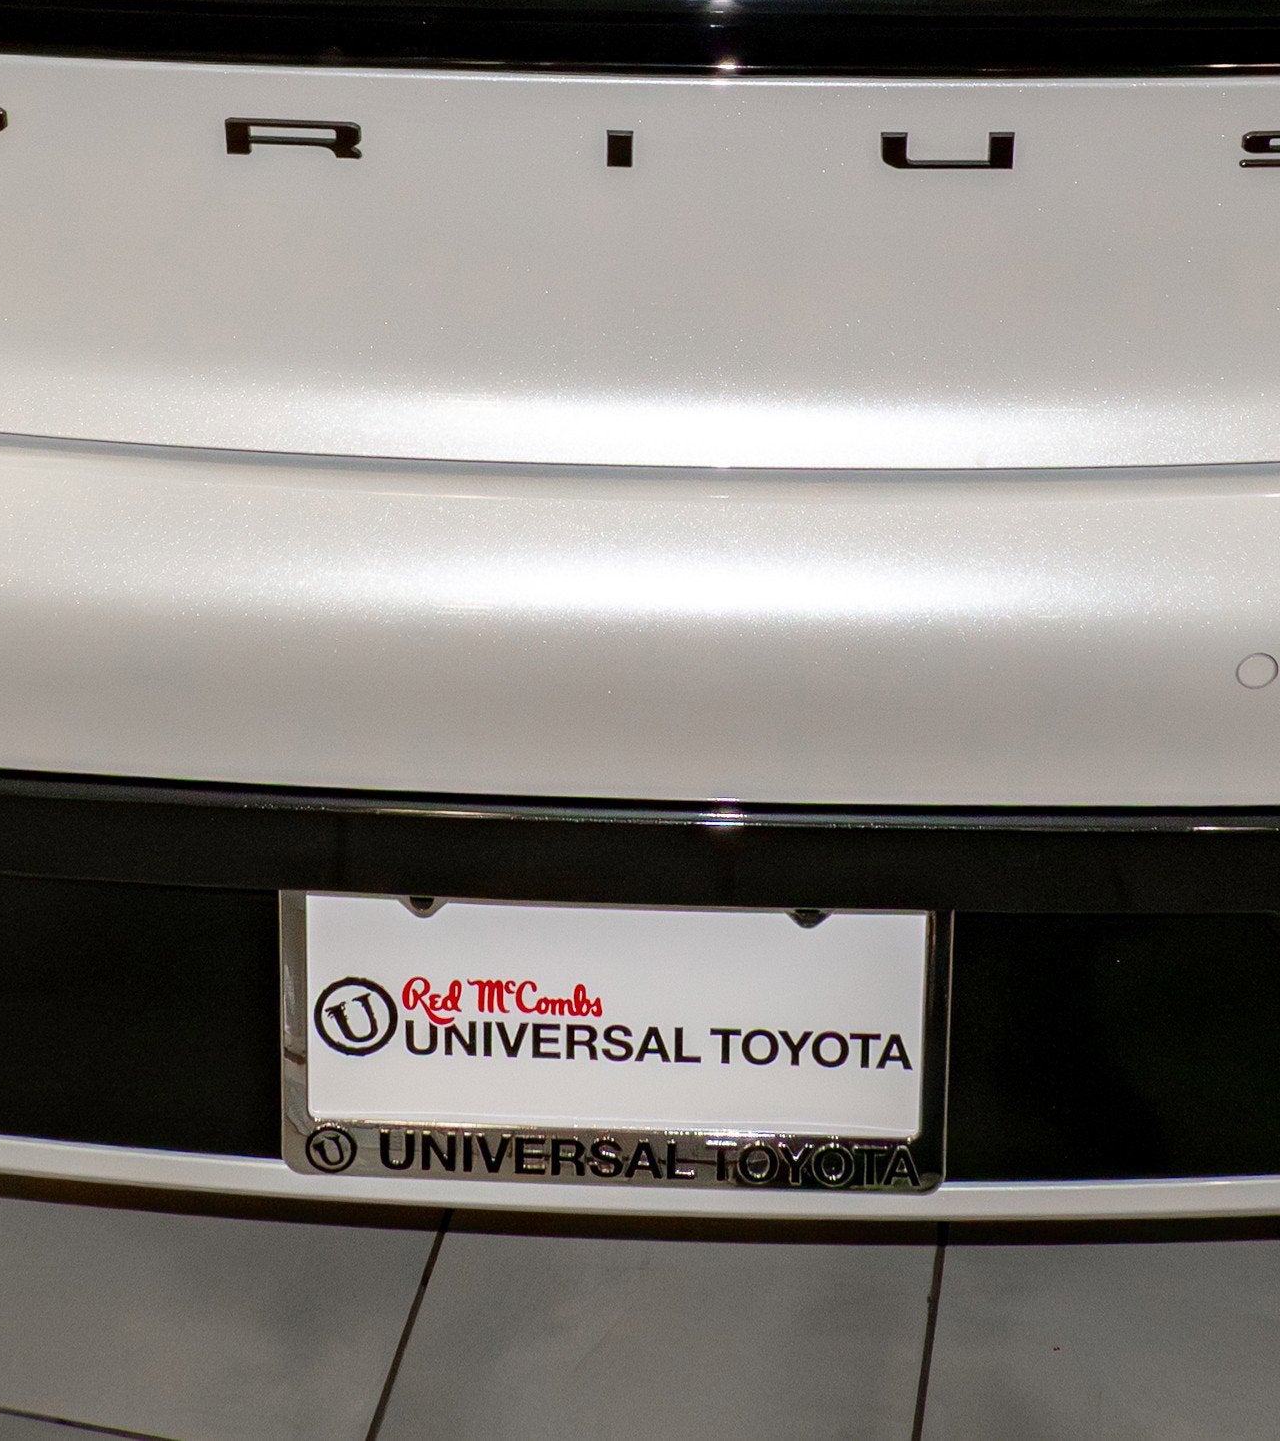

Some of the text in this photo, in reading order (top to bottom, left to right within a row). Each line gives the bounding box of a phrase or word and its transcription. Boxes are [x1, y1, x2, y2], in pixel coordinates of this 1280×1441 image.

[402, 976, 602, 1025] Red McCombs
[405, 1020, 913, 1071] UNIVERSAL TOYOTA
[378, 1128, 921, 1188] UNIVERSAL TOYOTA
